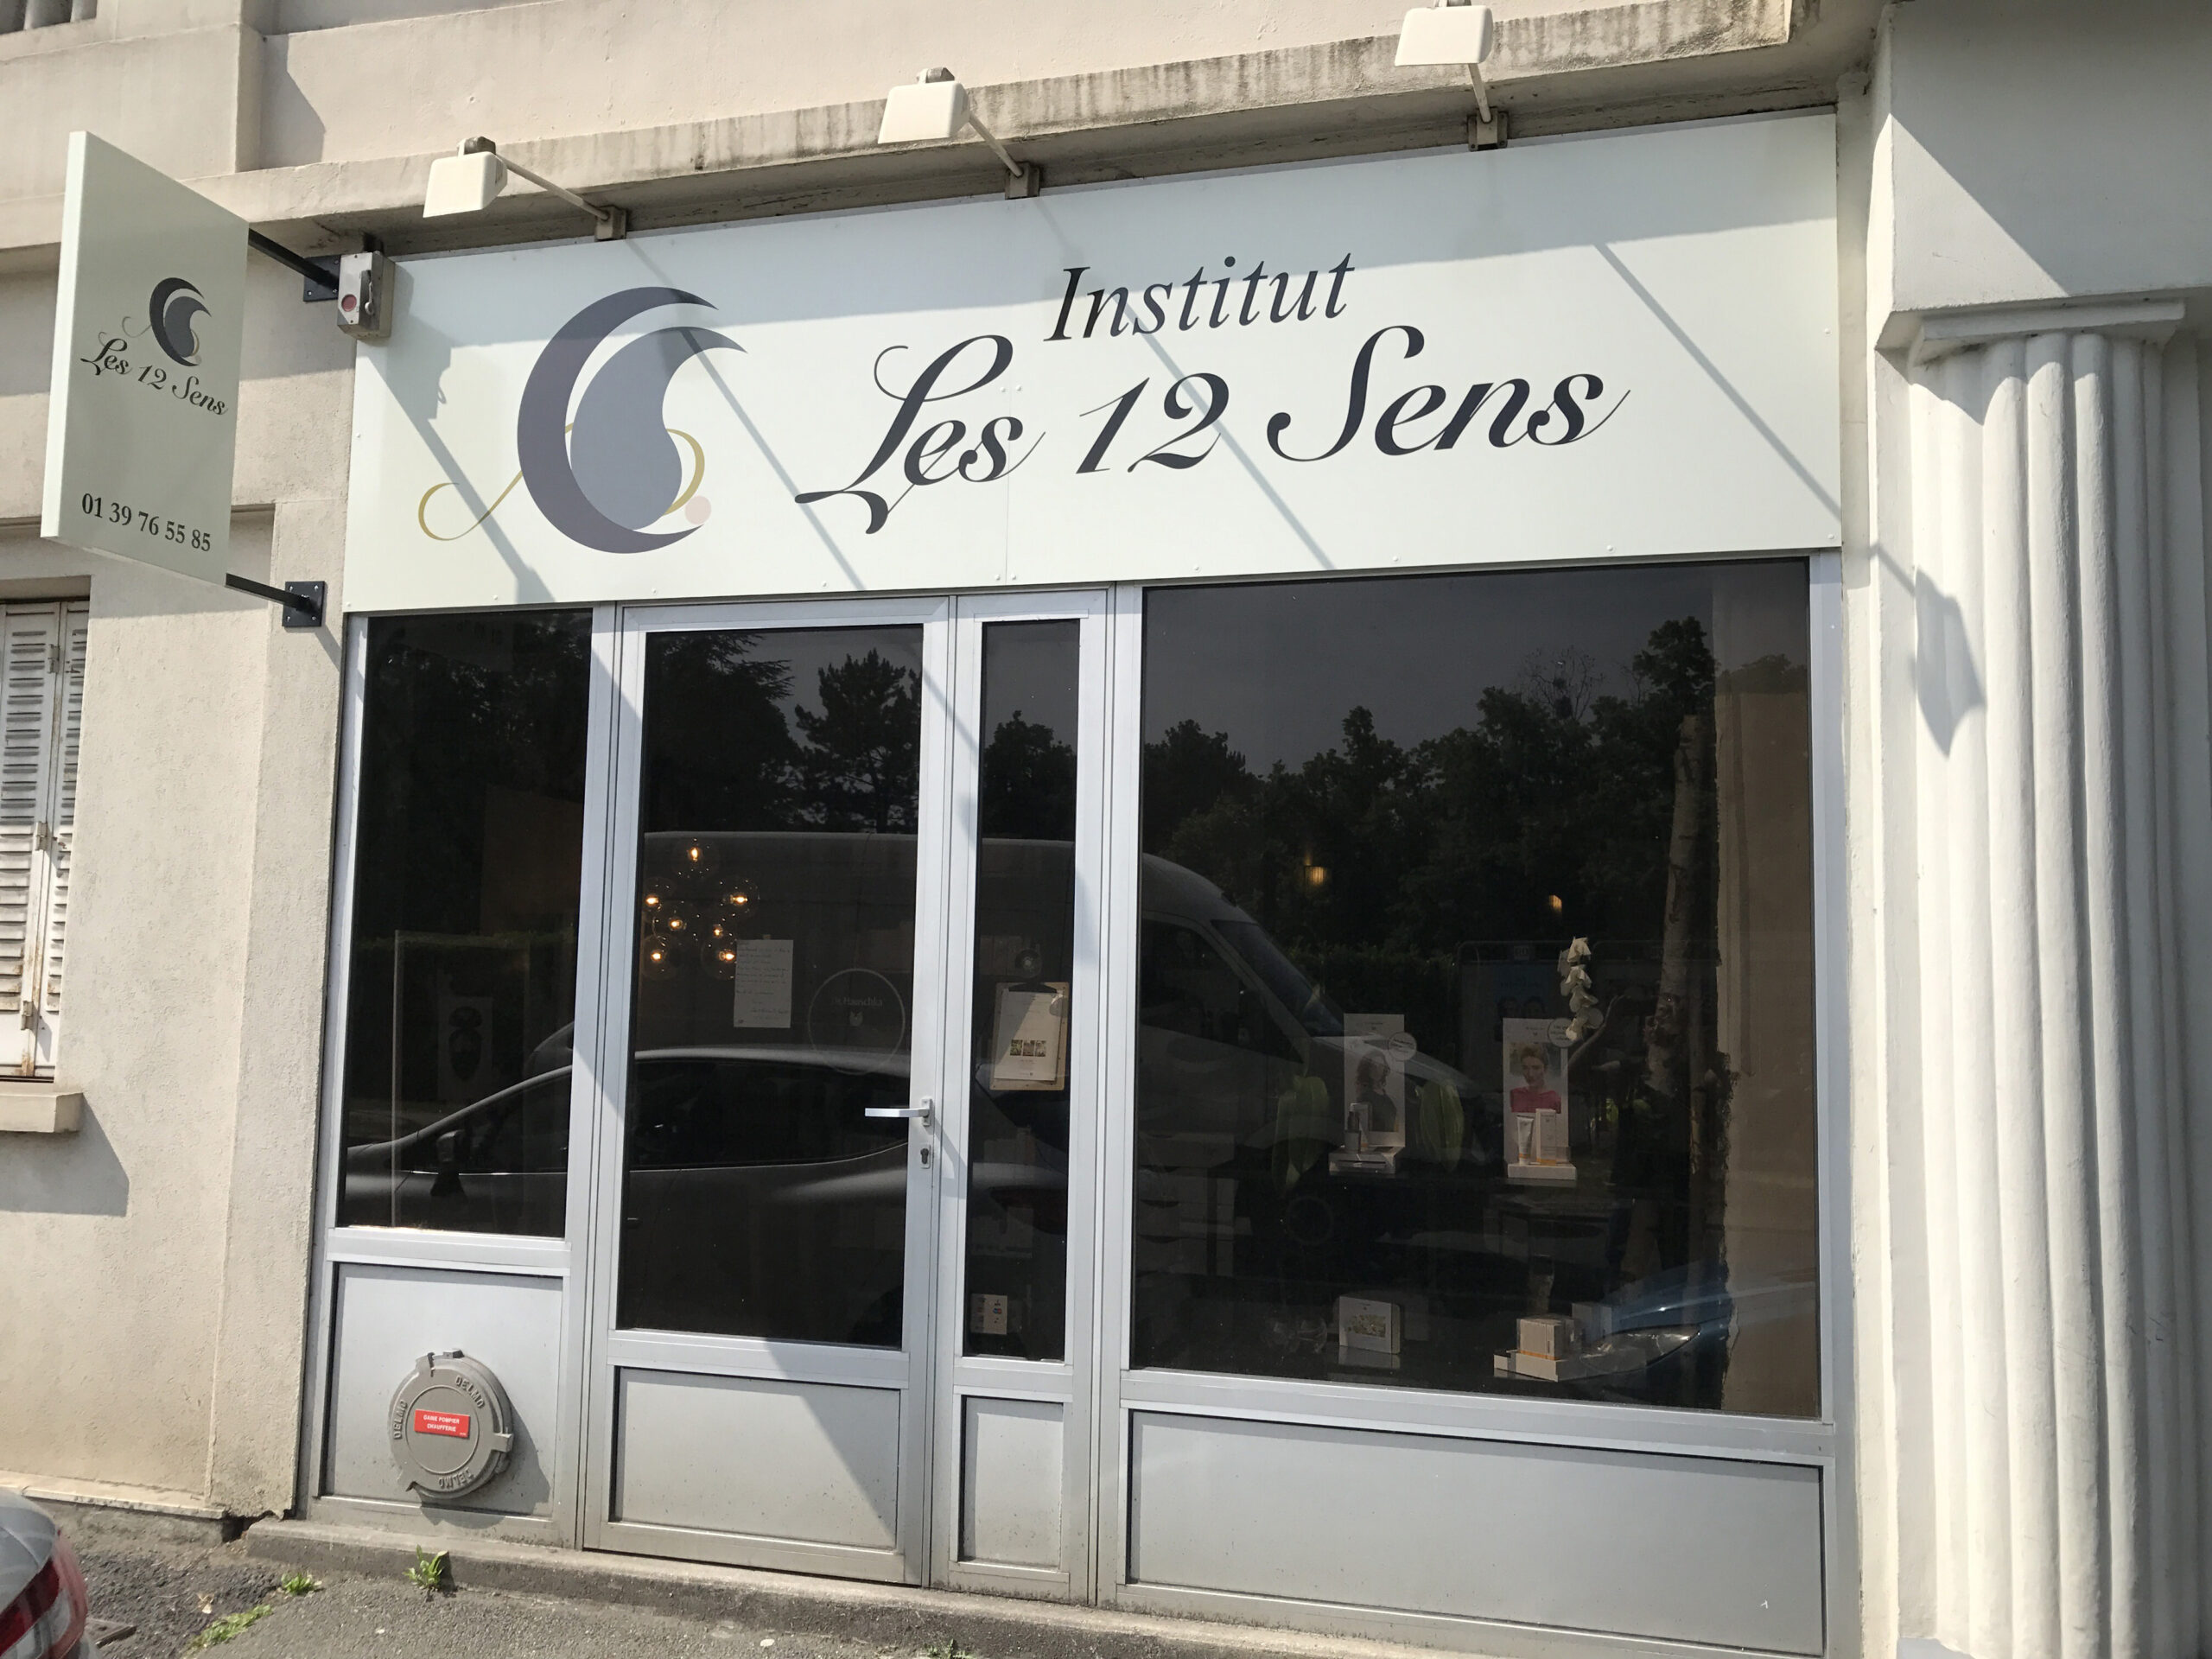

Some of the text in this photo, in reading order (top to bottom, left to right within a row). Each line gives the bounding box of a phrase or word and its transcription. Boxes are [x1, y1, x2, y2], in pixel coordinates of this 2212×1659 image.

[1044, 253, 1355, 340] Institut
[80, 331, 229, 416] Les 12 Sens
[795, 325, 1631, 534] Les 12 Sens
[81, 493, 211, 552] 01 39 76 55 85
[455, 1376, 485, 1408] DELMO
[393, 1400, 408, 1440] DELMO
[427, 1422, 457, 1433] CHAUFFERIE
[438, 1416, 460, 1425] POMPIER
